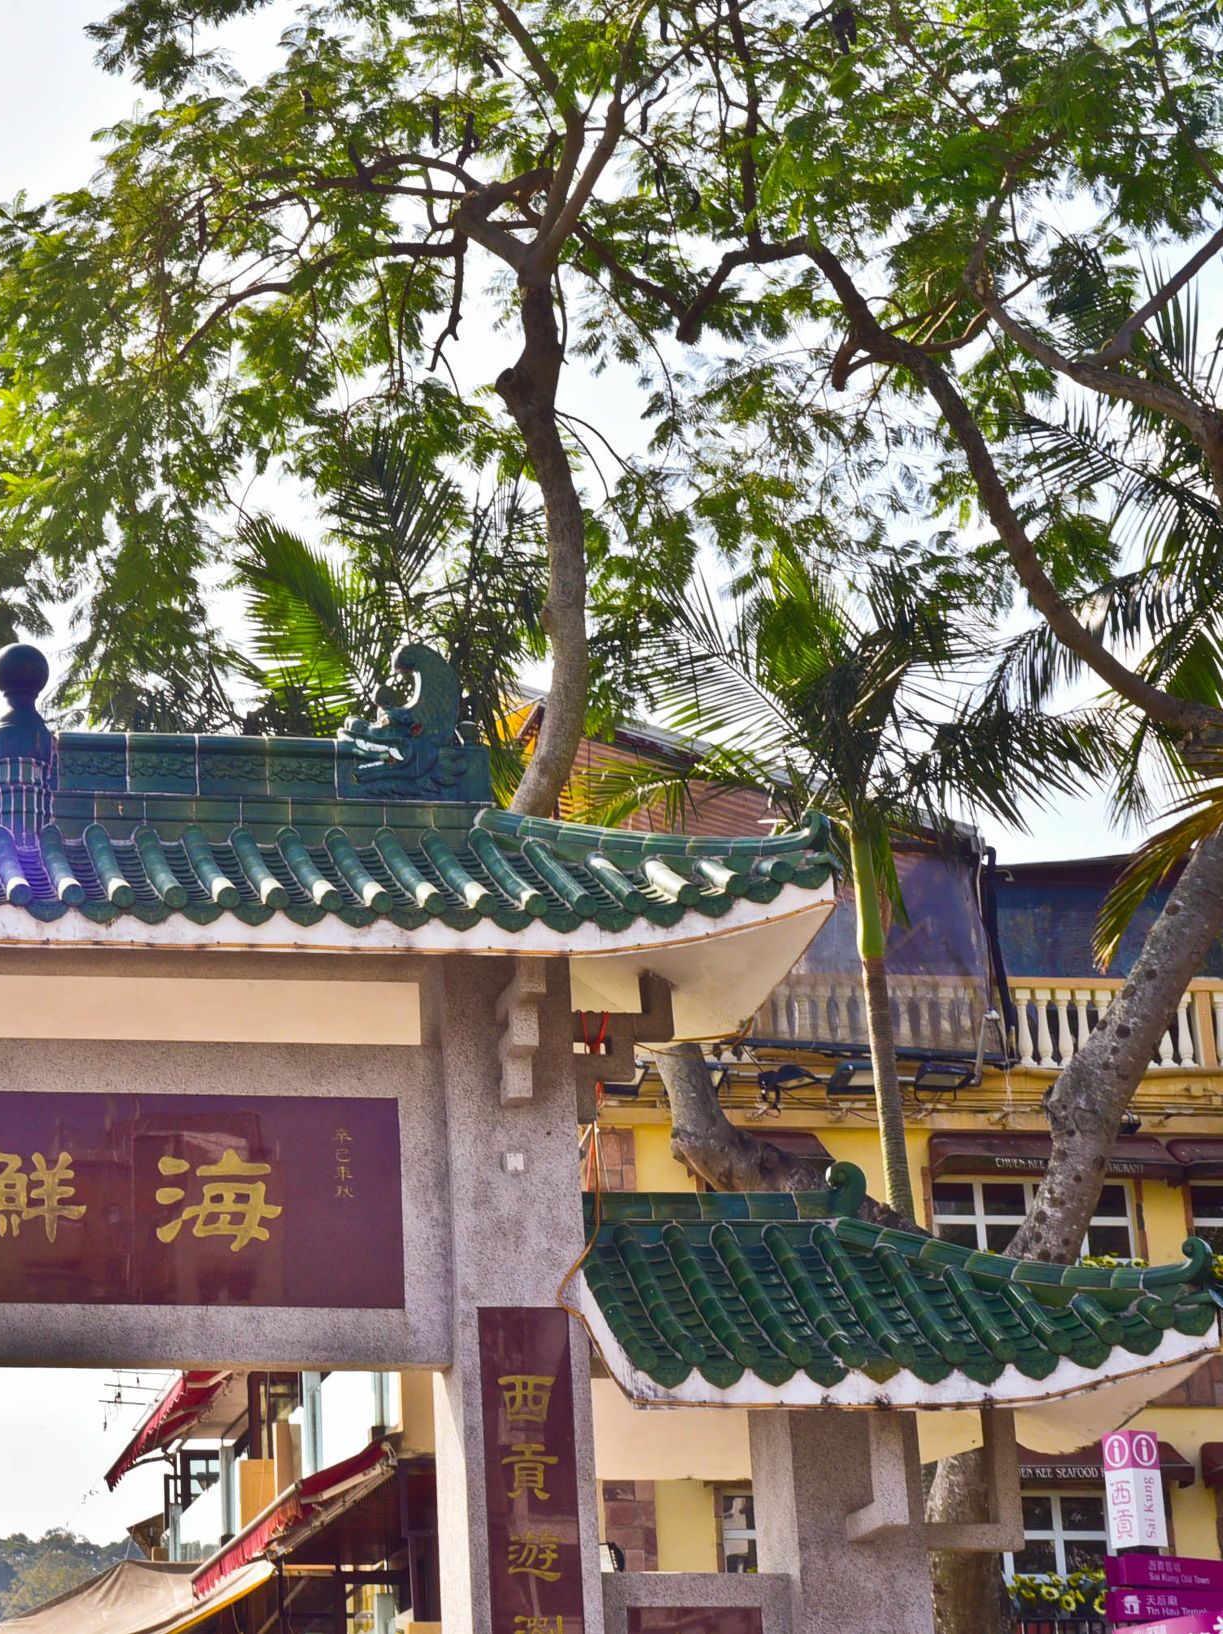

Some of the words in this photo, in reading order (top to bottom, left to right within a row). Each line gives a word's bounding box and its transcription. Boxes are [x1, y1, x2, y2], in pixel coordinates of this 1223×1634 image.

[1036, 1466, 1054, 1478] KEE
[1056, 1466, 1099, 1479] SEAFOOD
[1143, 1476, 1156, 1513] Kung
[1109, 1480, 1134, 1540] 西貢
[1146, 1518, 1157, 1539] Sai
[1146, 1606, 1160, 1615] Tin
[1162, 1607, 1180, 1616] Hau
